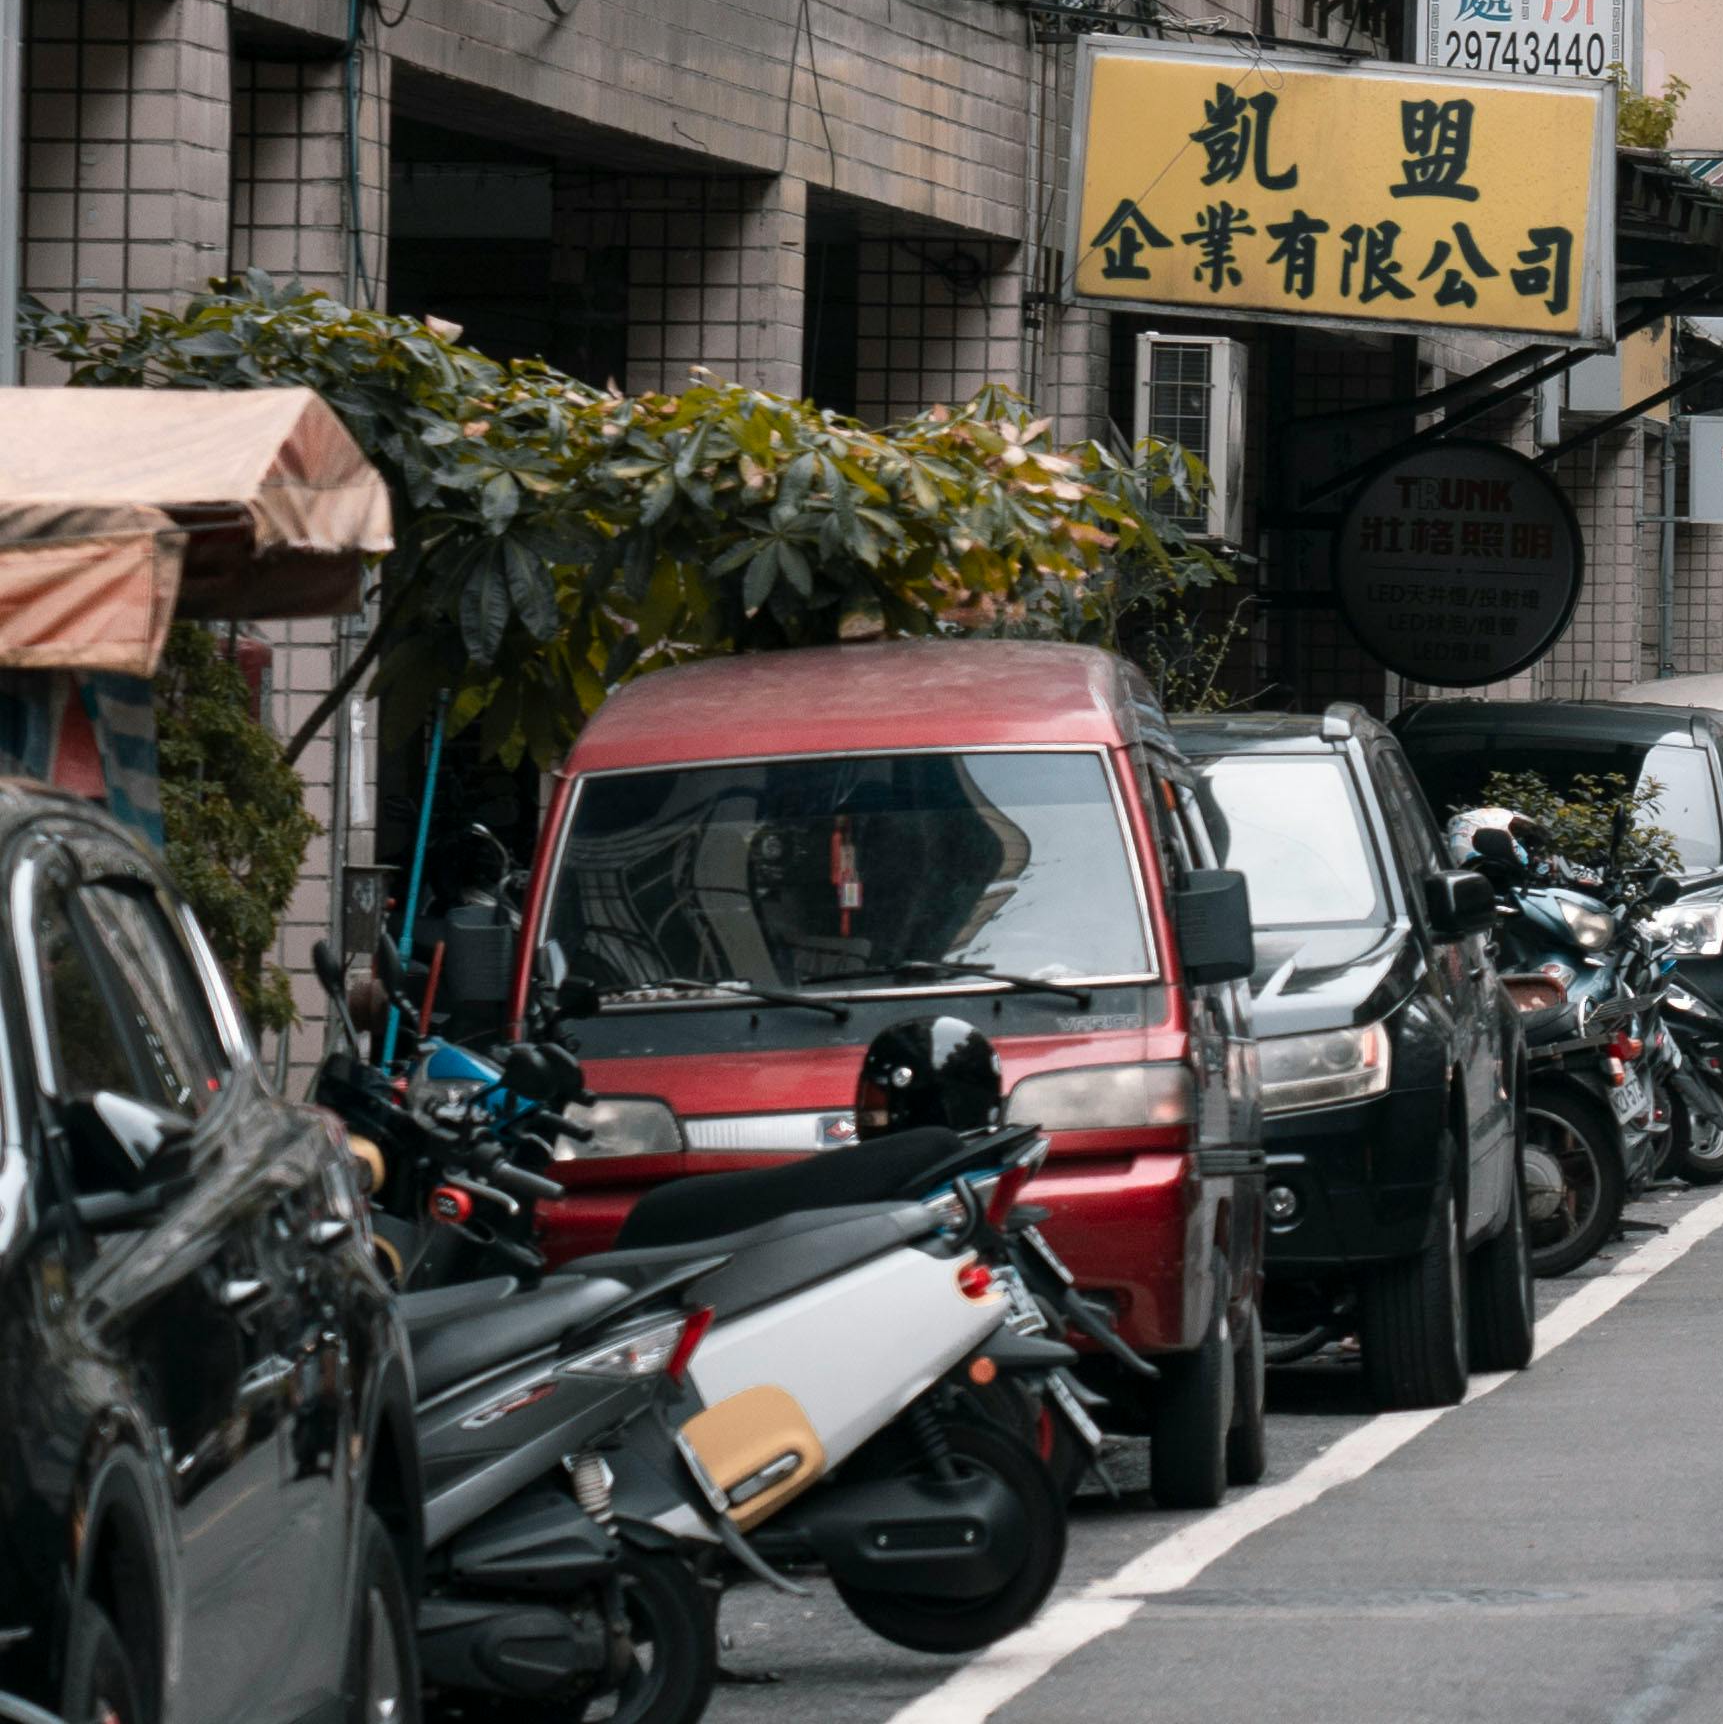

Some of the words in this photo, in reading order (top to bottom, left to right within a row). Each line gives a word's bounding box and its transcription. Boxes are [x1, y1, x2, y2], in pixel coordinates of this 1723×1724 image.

[1445, 30, 1605, 76] 29743440
[1189, 81, 1481, 203] 凱盟
[1090, 197, 1575, 317] 企業有限公司
[1393, 476, 1513, 512] TRUNK
